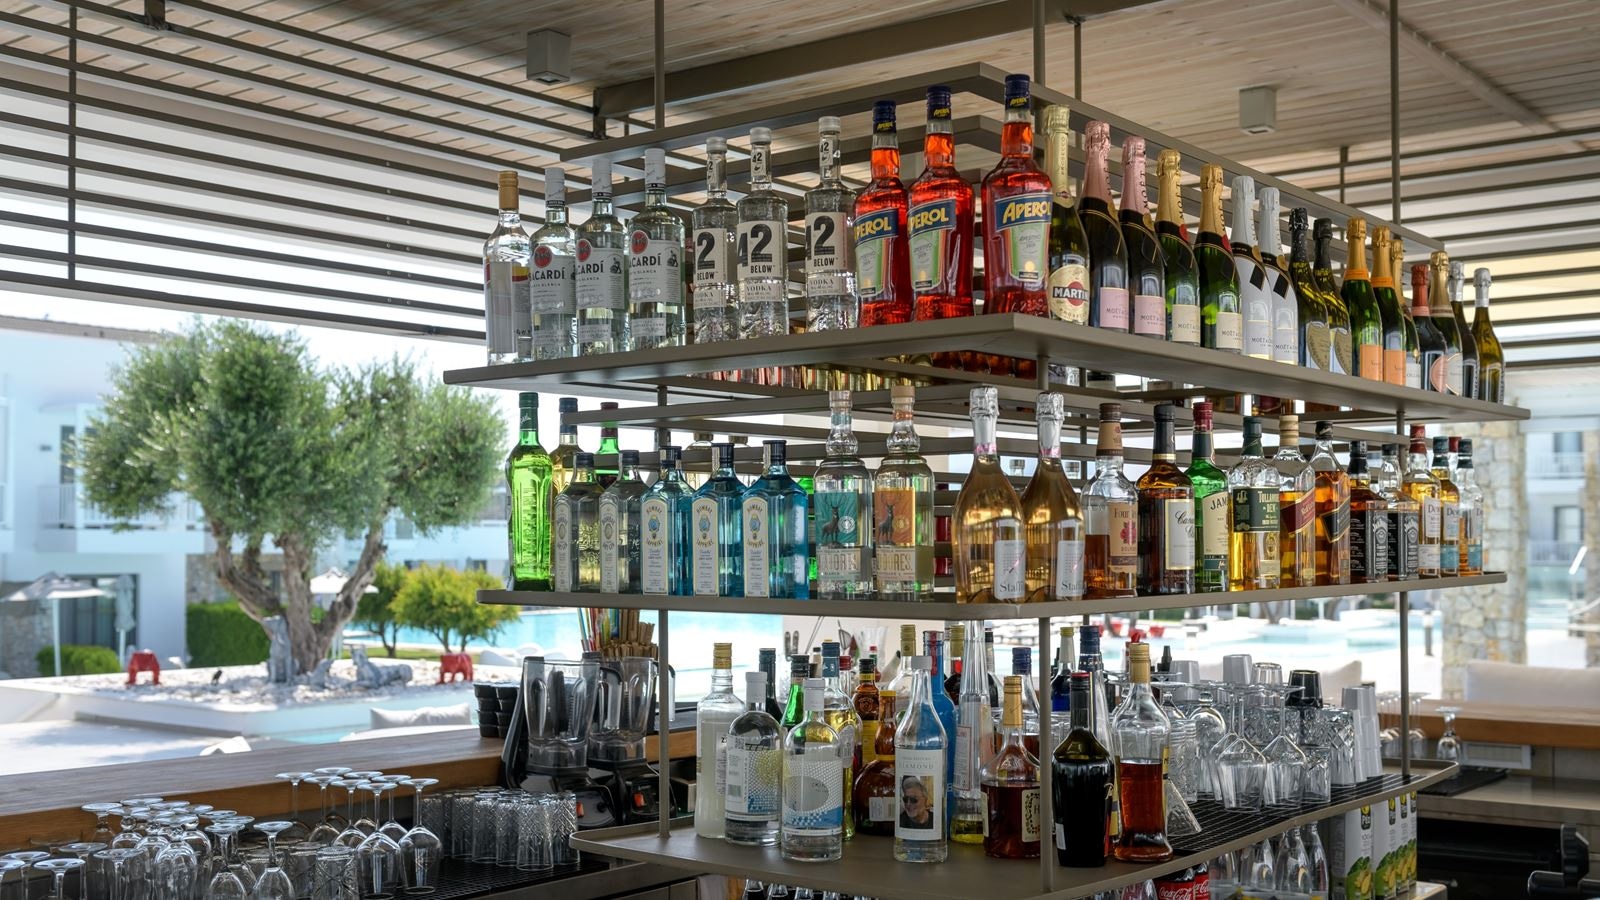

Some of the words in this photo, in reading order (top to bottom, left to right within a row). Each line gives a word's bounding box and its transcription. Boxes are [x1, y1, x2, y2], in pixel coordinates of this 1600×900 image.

[854, 216, 892, 241] PEROL
[738, 223, 773, 267] 42
[813, 257, 835, 267] BELOW
[750, 265, 772, 274] BELOW
[696, 271, 715, 281] BELOW
